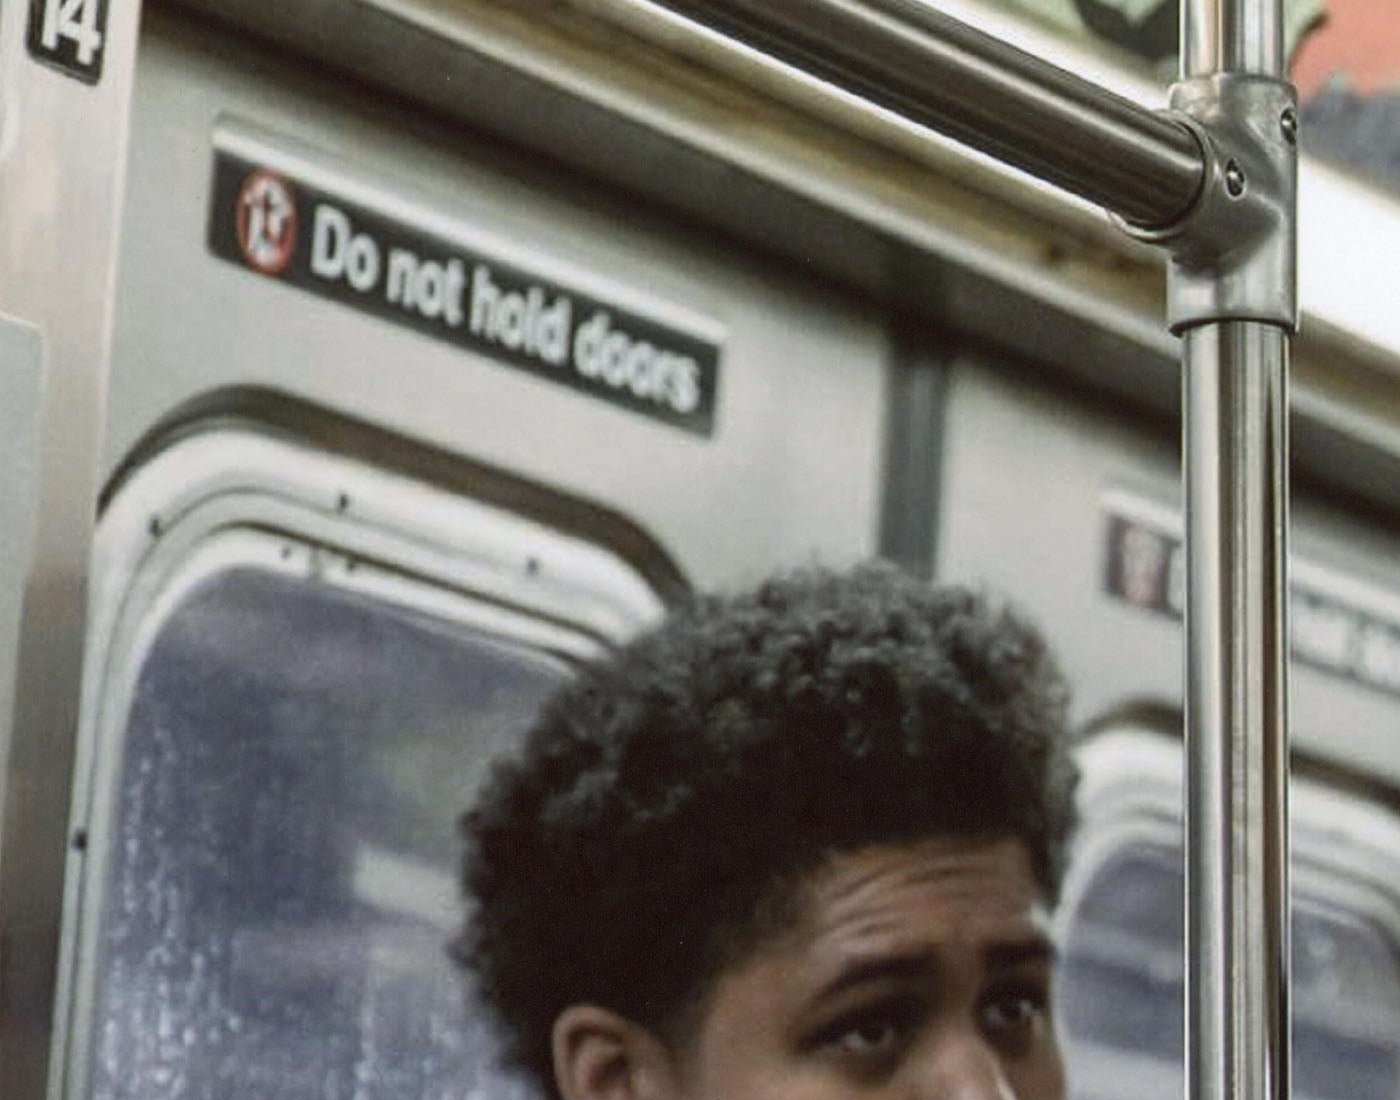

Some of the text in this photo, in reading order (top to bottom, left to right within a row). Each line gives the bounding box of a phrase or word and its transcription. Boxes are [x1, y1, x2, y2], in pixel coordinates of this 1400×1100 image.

[42, 0, 101, 65] 14
[310, 203, 700, 414] Do not hold doors
